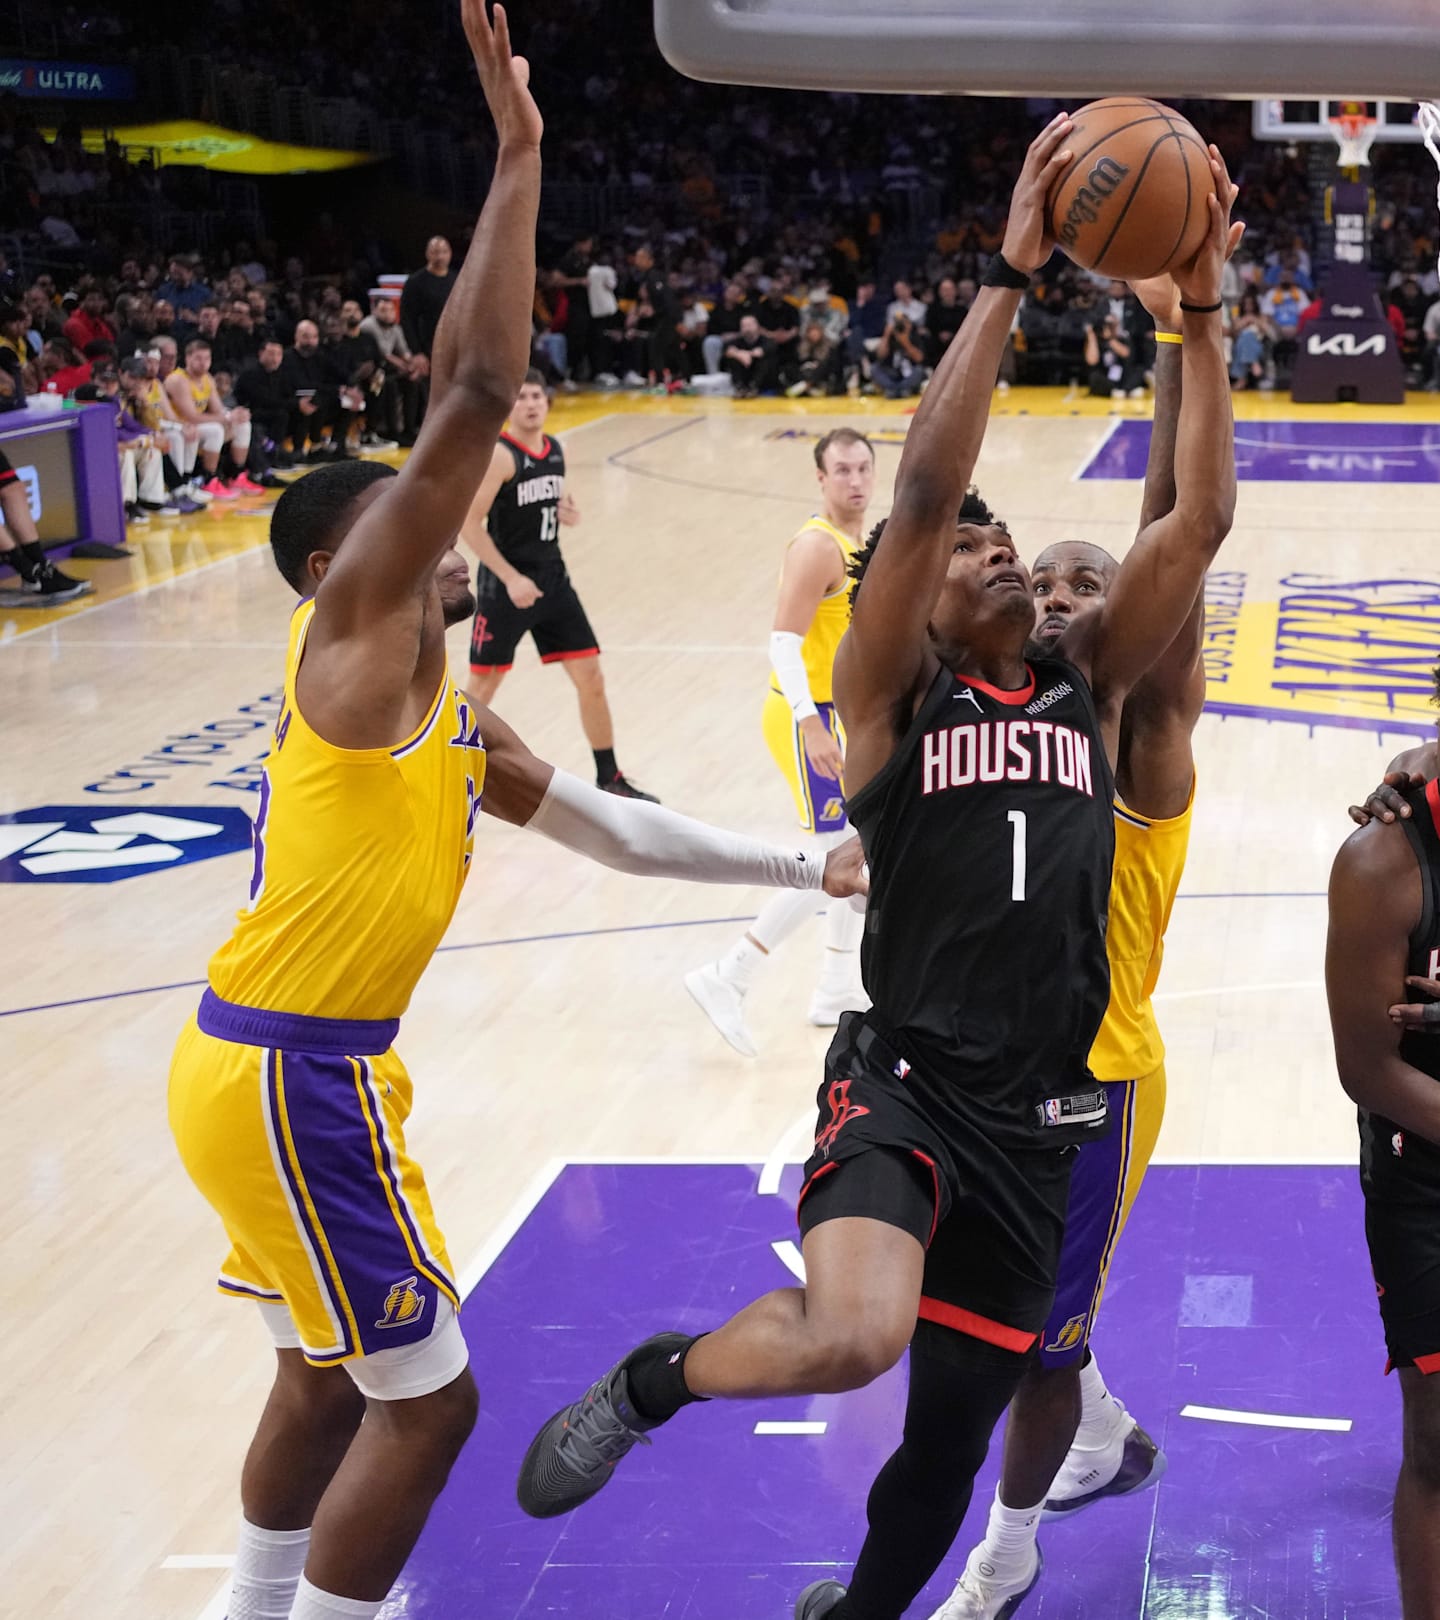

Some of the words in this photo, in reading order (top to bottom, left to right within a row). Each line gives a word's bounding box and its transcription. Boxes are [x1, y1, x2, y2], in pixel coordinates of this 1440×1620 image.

[38, 70, 103, 91] ULTRA
[1059, 155, 1129, 249] Wilson
[922, 720, 1094, 798] HOUSTON
[1007, 809, 1027, 901] 1
